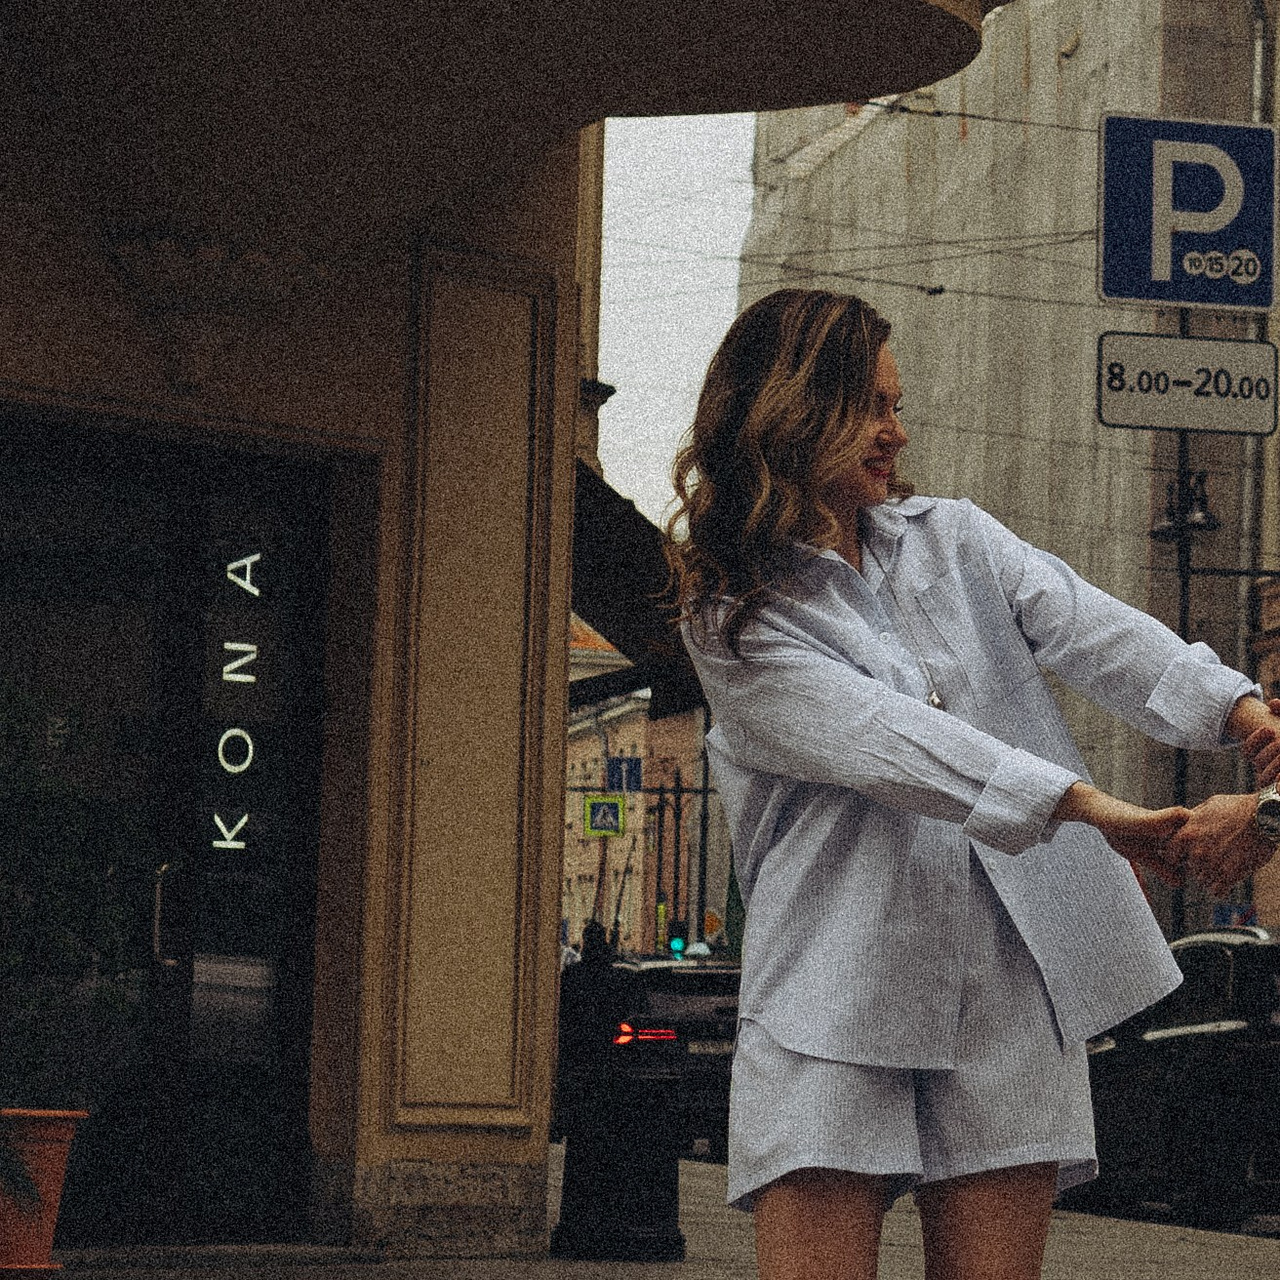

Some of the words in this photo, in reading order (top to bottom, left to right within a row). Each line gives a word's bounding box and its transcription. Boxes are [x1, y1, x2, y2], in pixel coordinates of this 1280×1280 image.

[1152, 140, 1244, 281] P
[1208, 256, 1225, 272] 15
[1231, 256, 1258, 277] 20
[212, 553, 261, 849] KONA
